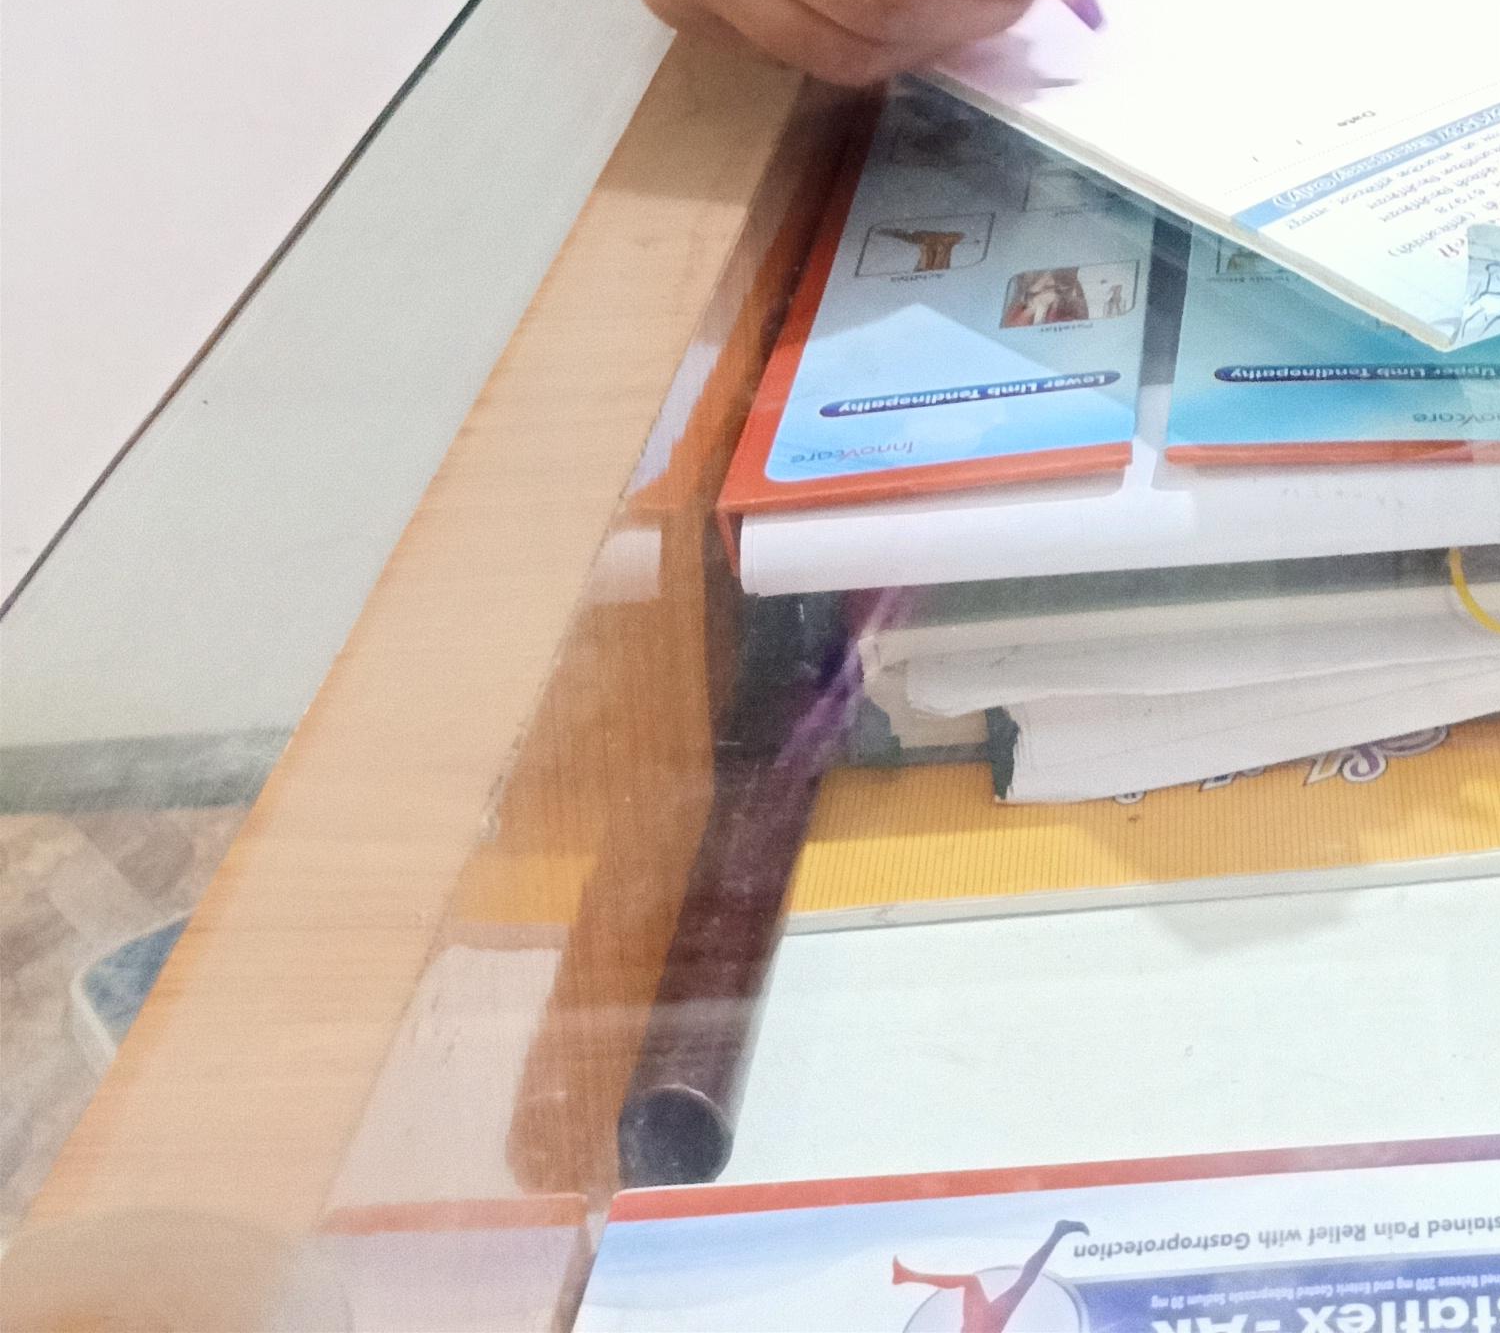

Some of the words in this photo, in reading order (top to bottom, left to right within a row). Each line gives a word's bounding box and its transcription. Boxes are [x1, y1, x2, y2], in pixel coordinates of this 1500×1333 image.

[1045, 373, 1105, 390] Lower
[1230, 365, 1370, 380] Tendinopathy
[1375, 366, 1427, 378] Limb
[987, 381, 1038, 398] Limb
[838, 386, 981, 415] Tendinopathy
[1258, 1228, 1301, 1249] with
[1308, 1223, 1366, 1246] Relief
[1374, 1220, 1419, 1239] Pain
[1073, 1232, 1251, 1261] Gastroprotection
